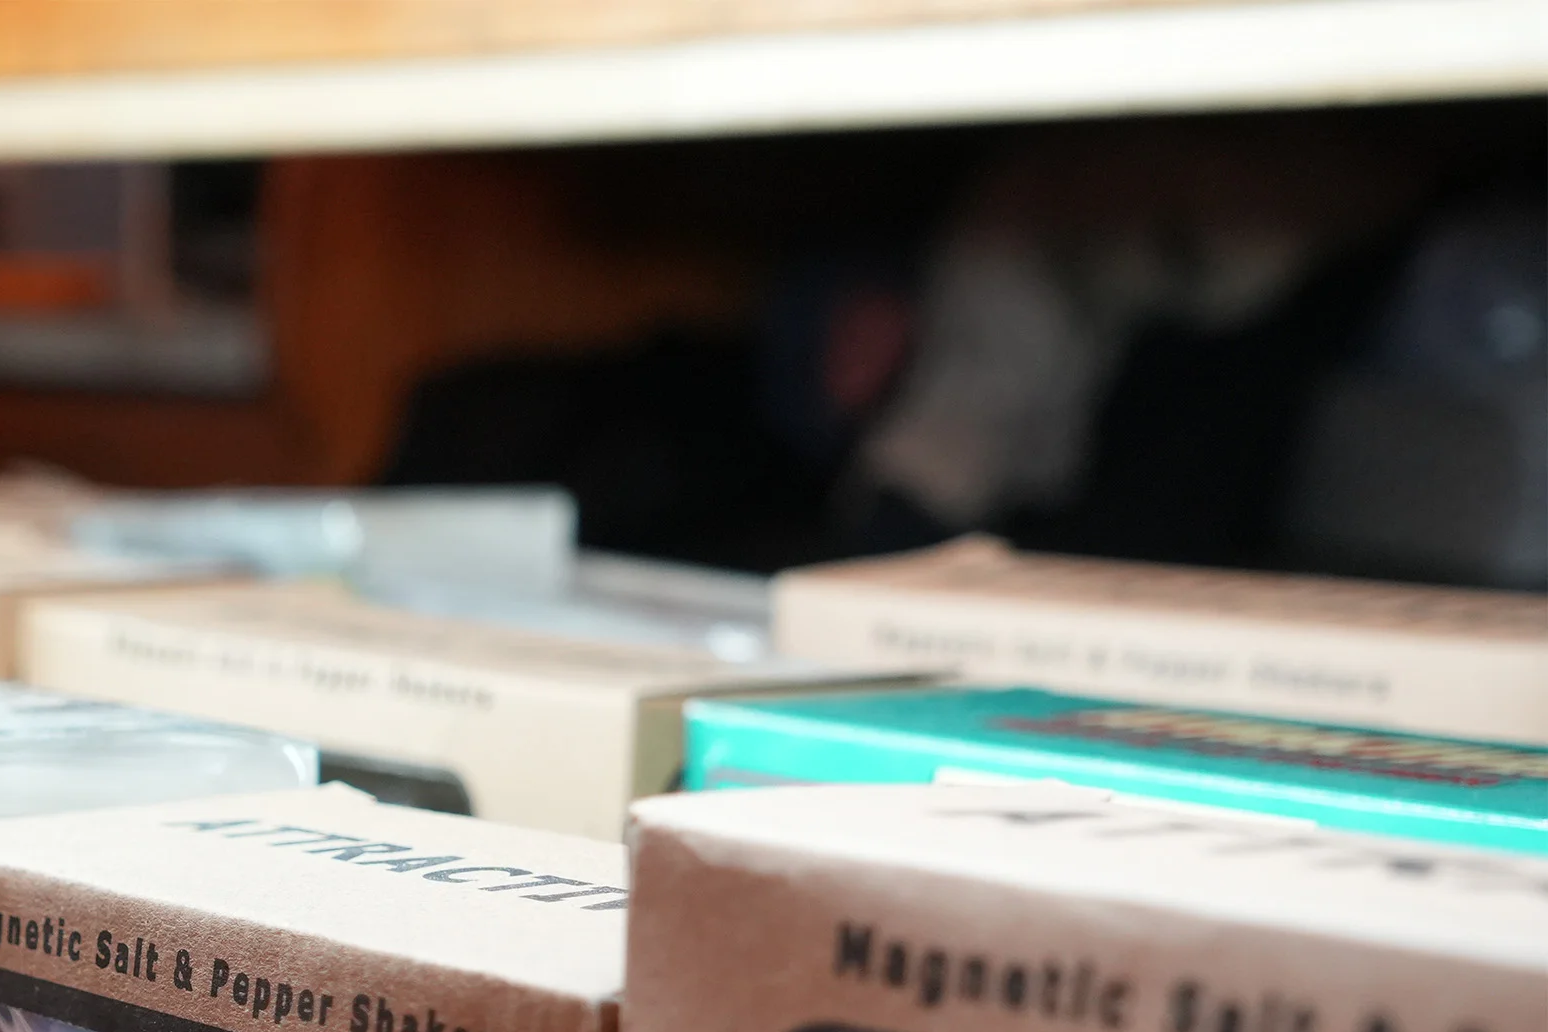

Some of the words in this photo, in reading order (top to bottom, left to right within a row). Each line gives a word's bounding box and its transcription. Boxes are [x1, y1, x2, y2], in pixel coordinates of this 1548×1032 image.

[95, 929, 159, 983] Salt
[174, 949, 193, 991] &
[210, 957, 333, 1025] Pepper
[835, 920, 1131, 1032] Magnetic
